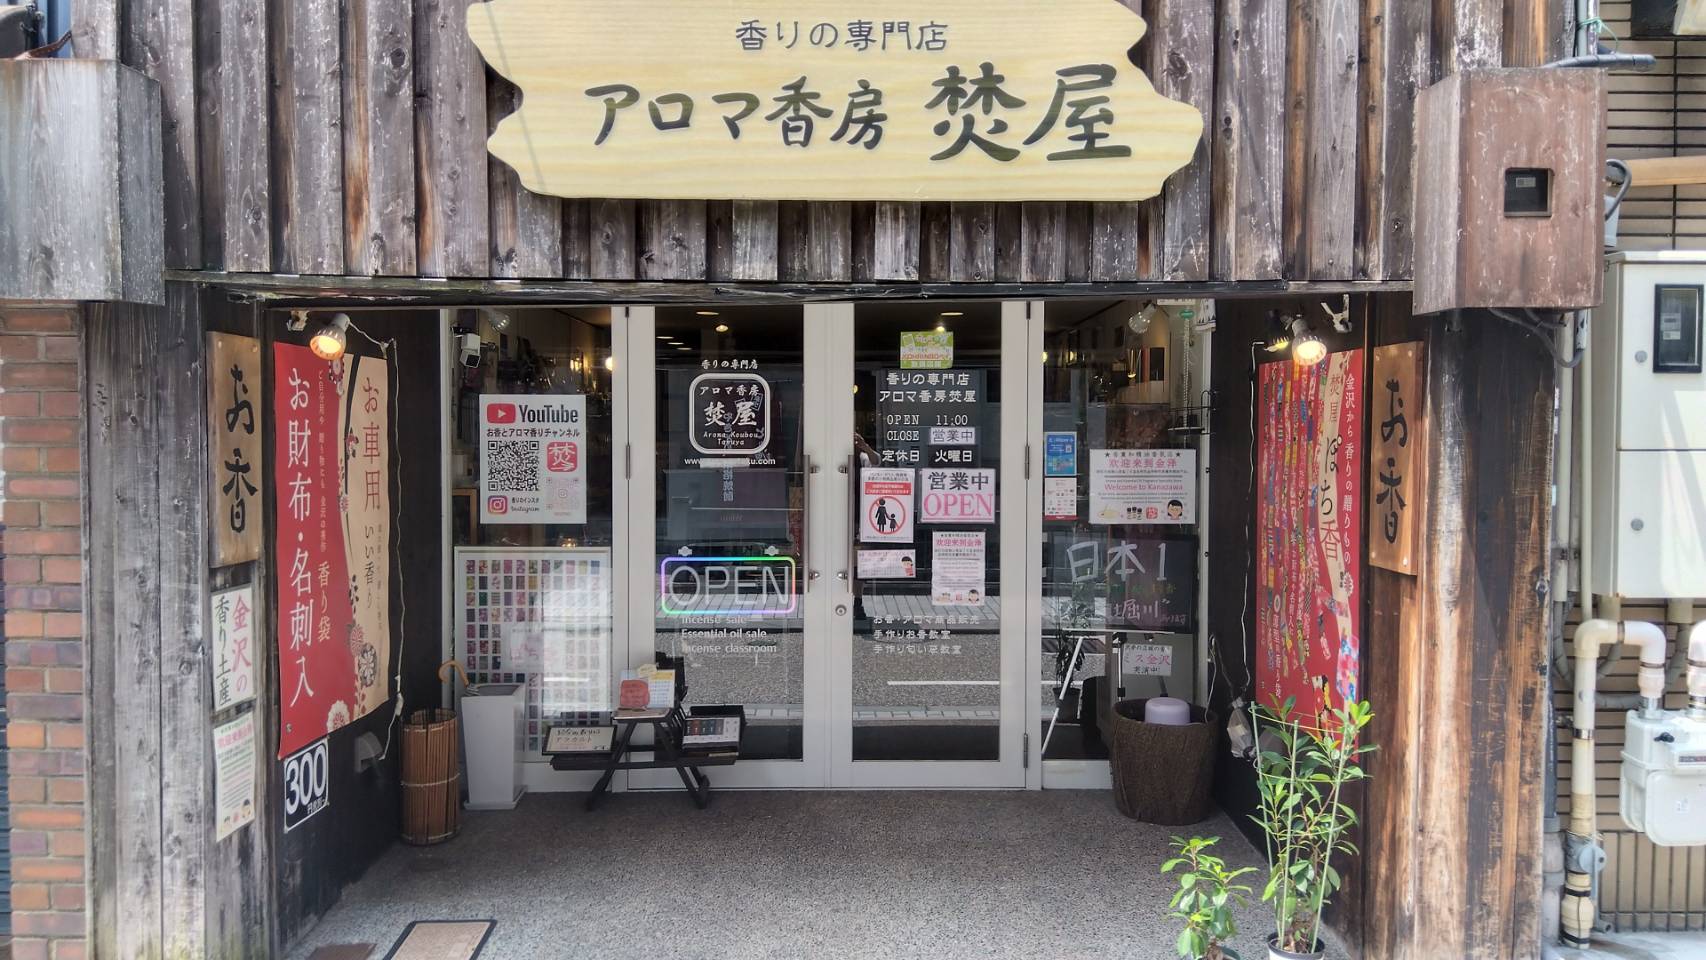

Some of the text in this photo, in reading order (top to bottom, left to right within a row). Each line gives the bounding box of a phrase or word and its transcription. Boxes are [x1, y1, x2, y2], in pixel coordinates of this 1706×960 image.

[735, 20, 948, 52] 香りの専門店
[584, 61, 1132, 162] アロマ香房 焚屋
[701, 359, 758, 370] 香りの専門店
[886, 372, 970, 386] 香りの専門店
[700, 384, 760, 397] アロマ香房
[879, 390, 976, 403] アロマ香房焚屋
[518, 404, 579, 423] YouTube
[703, 401, 757, 426] 焚屋
[886, 414, 968, 426] OPEN 11:00
[486, 428, 580, 438] お香とアロマ香りチャンネル
[886, 430, 920, 441] CLOSE
[932, 429, 973, 443] 営業中
[222, 364, 259, 533] お香
[362, 377, 381, 512] お車用
[882, 449, 973, 462] 定休日 火曜日
[1375, 379, 1408, 544] お香
[928, 472, 990, 491] 営業中
[1104, 483, 1138, 491] Welcome
[1139, 483, 1146, 491] to
[923, 493, 993, 517] OPEN
[287, 368, 315, 708] お財布・名刺入
[669, 566, 789, 605] OPEN
[317, 561, 332, 643] 香り袋
[681, 628, 768, 638] Essential oil sale
[725, 643, 777, 653] classroom
[285, 744, 327, 815] 300
